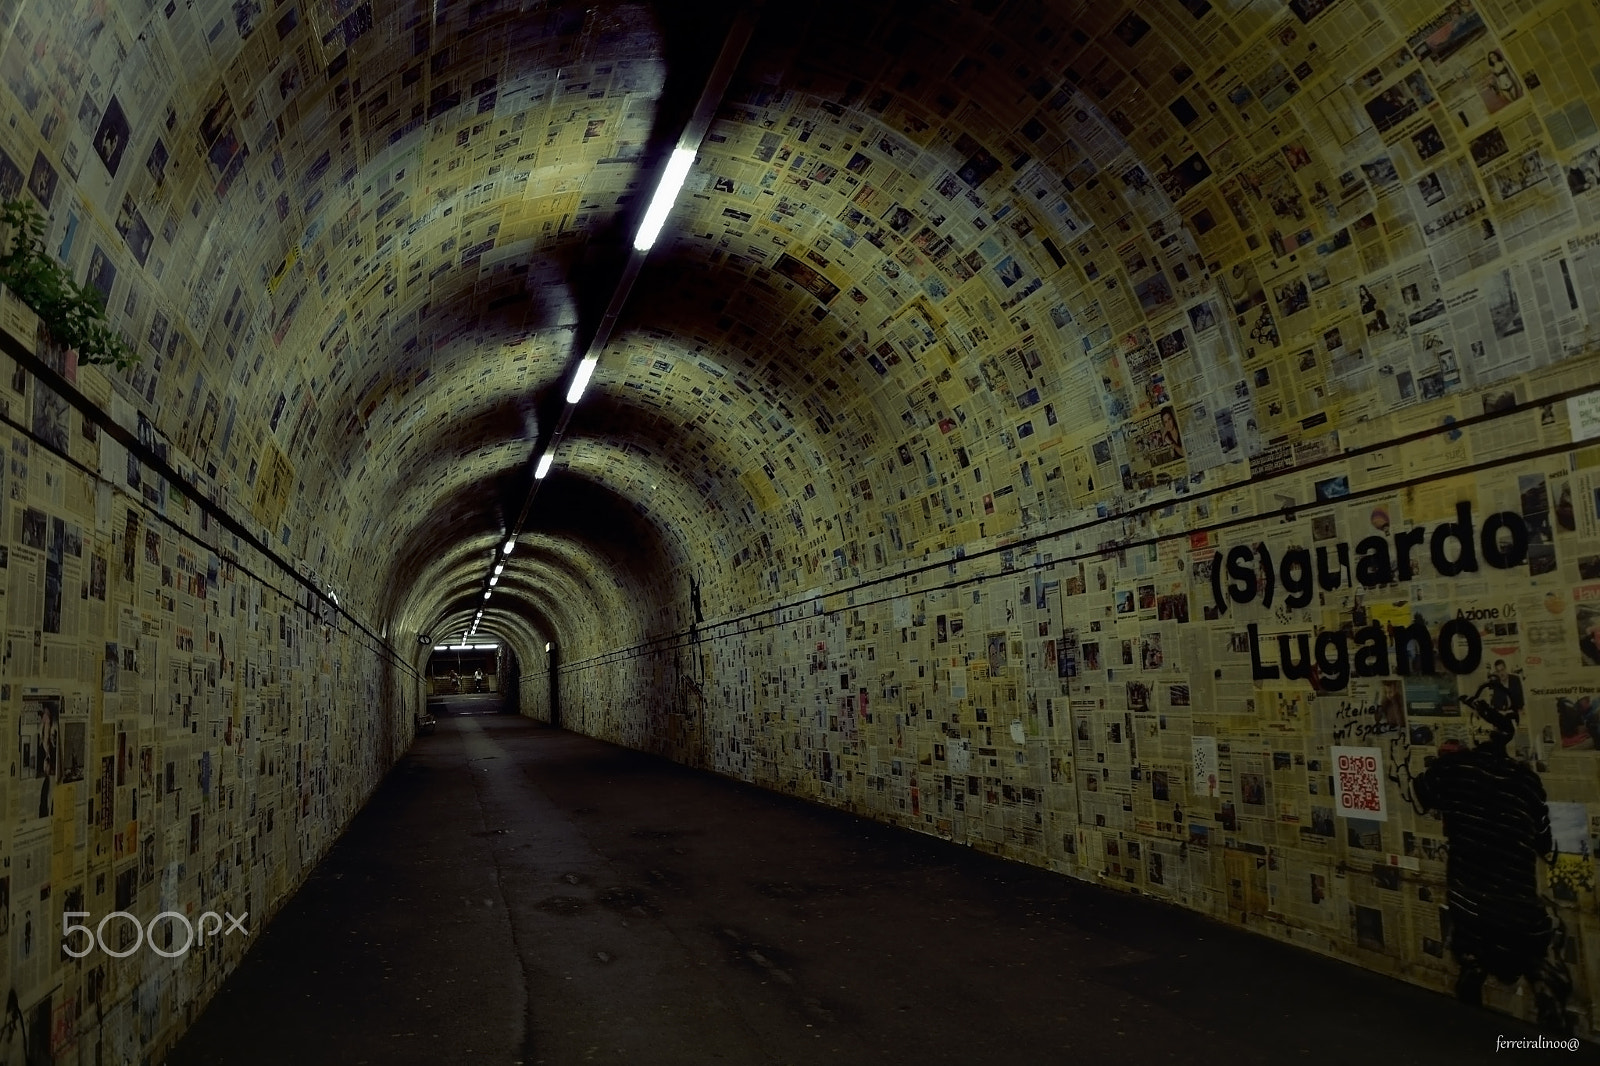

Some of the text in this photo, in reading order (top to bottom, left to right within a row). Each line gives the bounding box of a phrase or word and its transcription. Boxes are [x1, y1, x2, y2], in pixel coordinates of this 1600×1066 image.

[1211, 501, 1529, 615] (S)guardo
[1456, 606, 1499, 620] Azione
[1247, 619, 1483, 692] Lugano
[1336, 700, 1384, 719] Atelier
